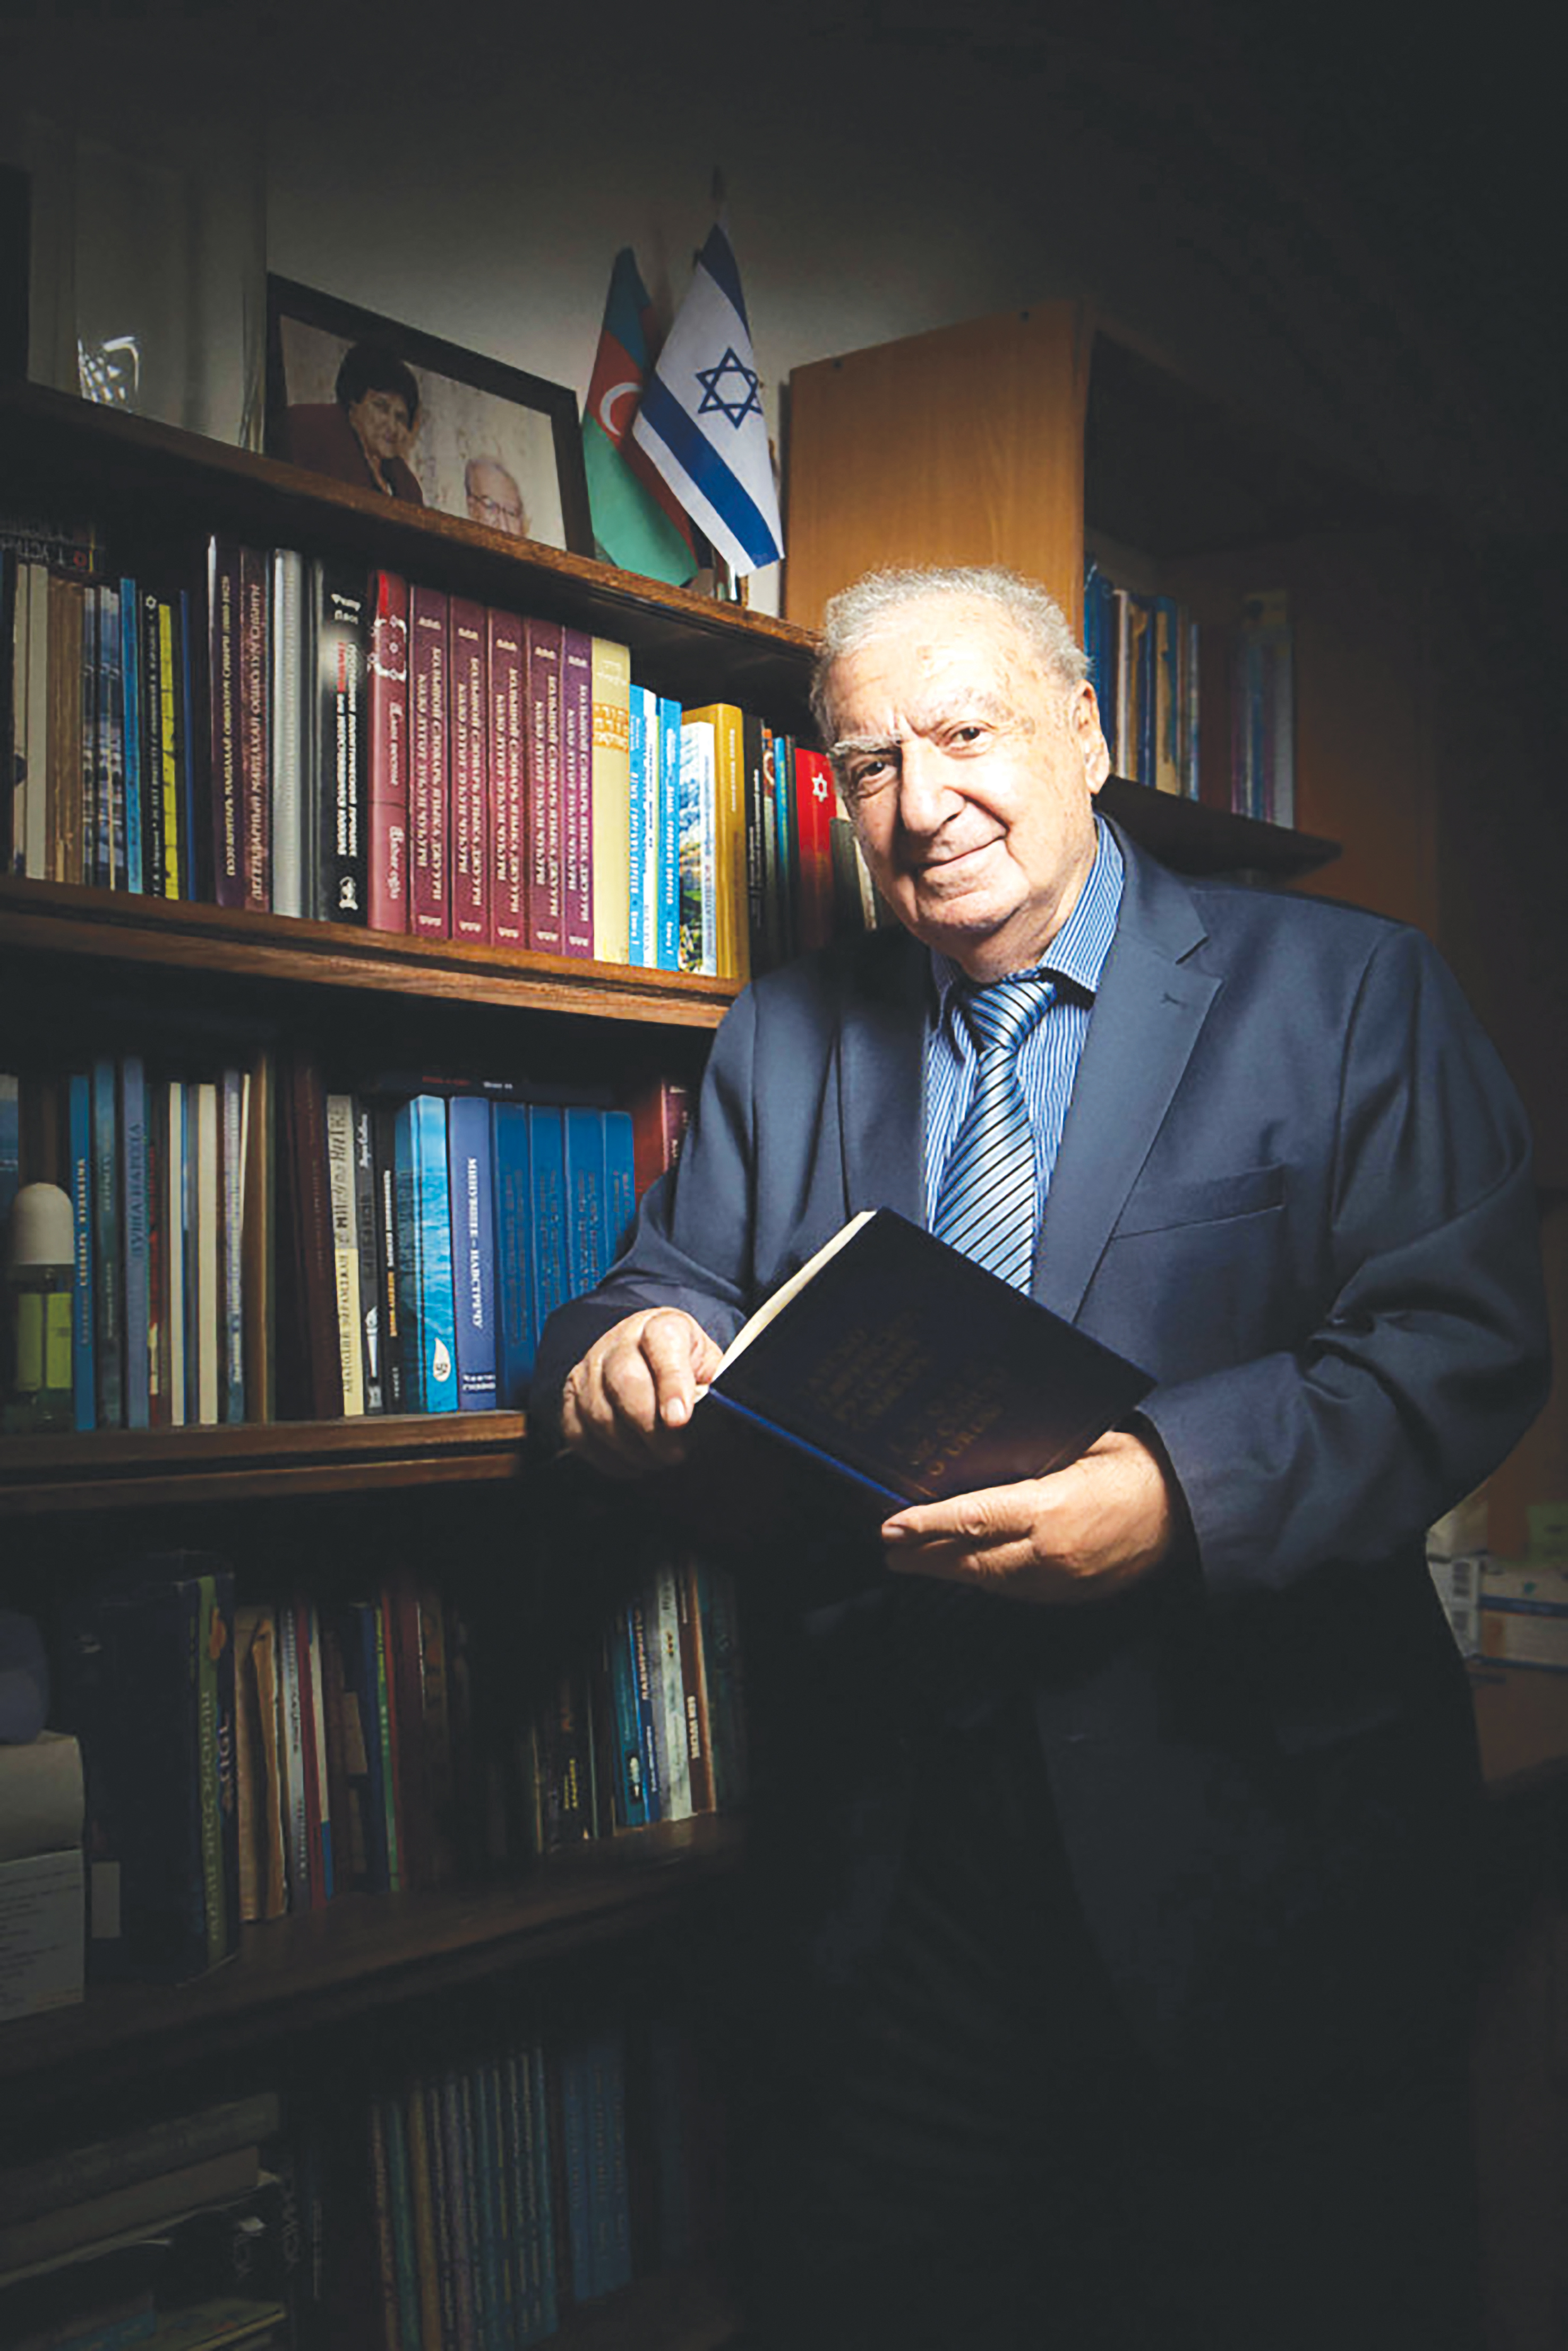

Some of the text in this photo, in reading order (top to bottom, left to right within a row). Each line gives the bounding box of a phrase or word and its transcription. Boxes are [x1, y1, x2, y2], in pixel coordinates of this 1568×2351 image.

[432, 646, 441, 717] БОЛЬШОЙ
[470, 657, 481, 727] БОЛЬШОЙ
[509, 668, 519, 736] БОЛЬШОЙ
[547, 676, 558, 743] БОЛЬШОЙ
[579, 685, 589, 750] БОЛЬШОЙ
[432, 720, 441, 784] СЛОВАРЬ
[470, 730, 481, 792] СЛОВАРЬ
[509, 739, 519, 801] СЛОВАРЬ
[547, 746, 558, 808] СЛОВАРЬ
[432, 788, 441, 835] ЯЗЫКА
[579, 753, 589, 814] СЛОВАРЬ
[470, 796, 481, 842] ЯЗЫКА
[509, 804, 519, 849] ЯЗЫКА
[547, 810, 558, 854] ЯЗЫКА
[579, 816, 589, 861] ЯЗЫКА
